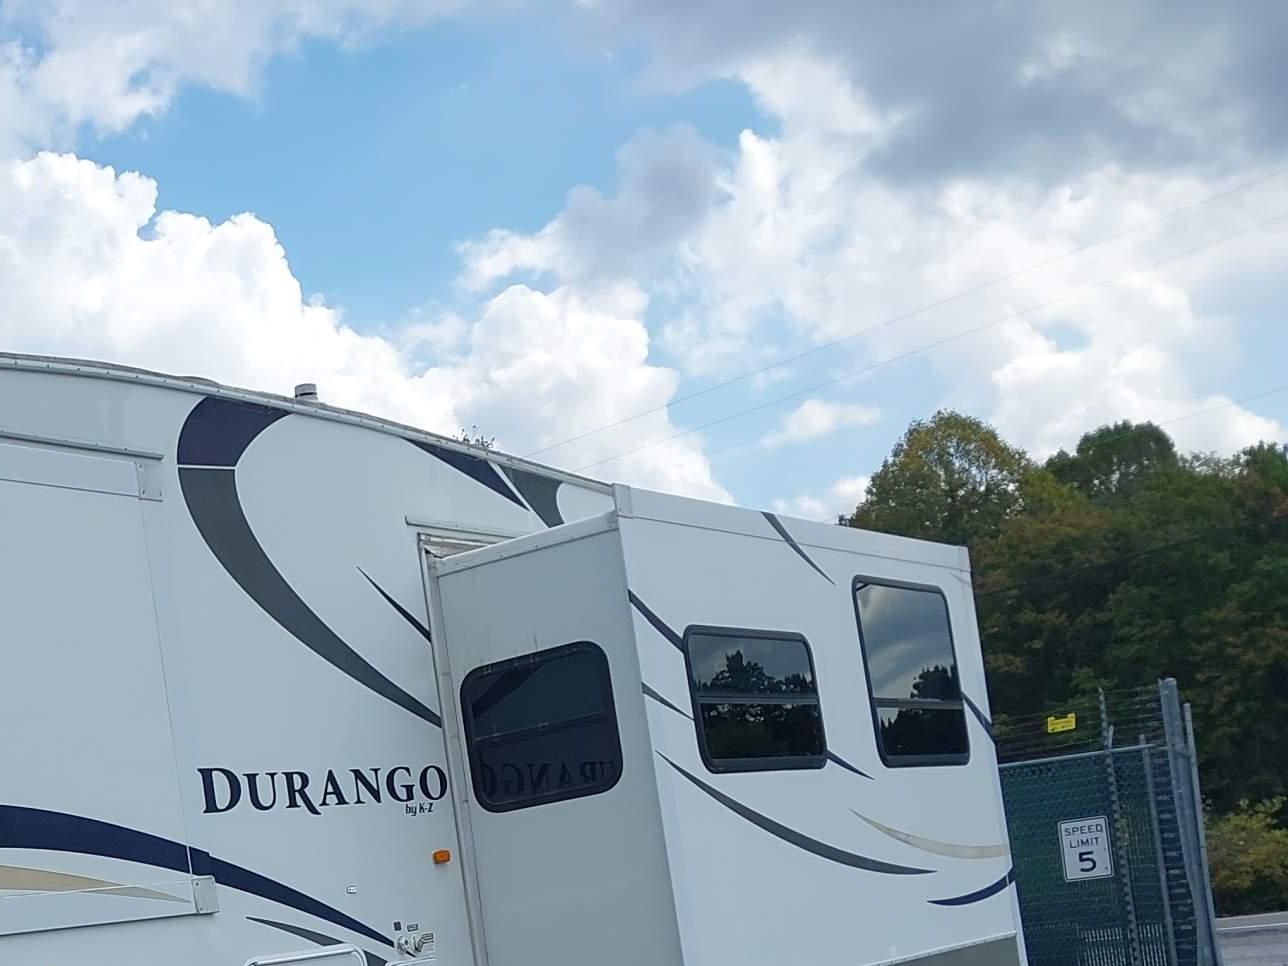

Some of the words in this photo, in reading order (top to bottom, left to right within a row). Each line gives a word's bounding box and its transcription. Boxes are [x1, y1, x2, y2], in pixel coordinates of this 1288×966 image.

[197, 765, 448, 815] DURANGO
[405, 803, 417, 816] by
[419, 802, 433, 813] K-Z
[1064, 824, 1103, 836] SPEED
[1070, 837, 1099, 848] LIMIT
[1079, 851, 1096, 872] 5
